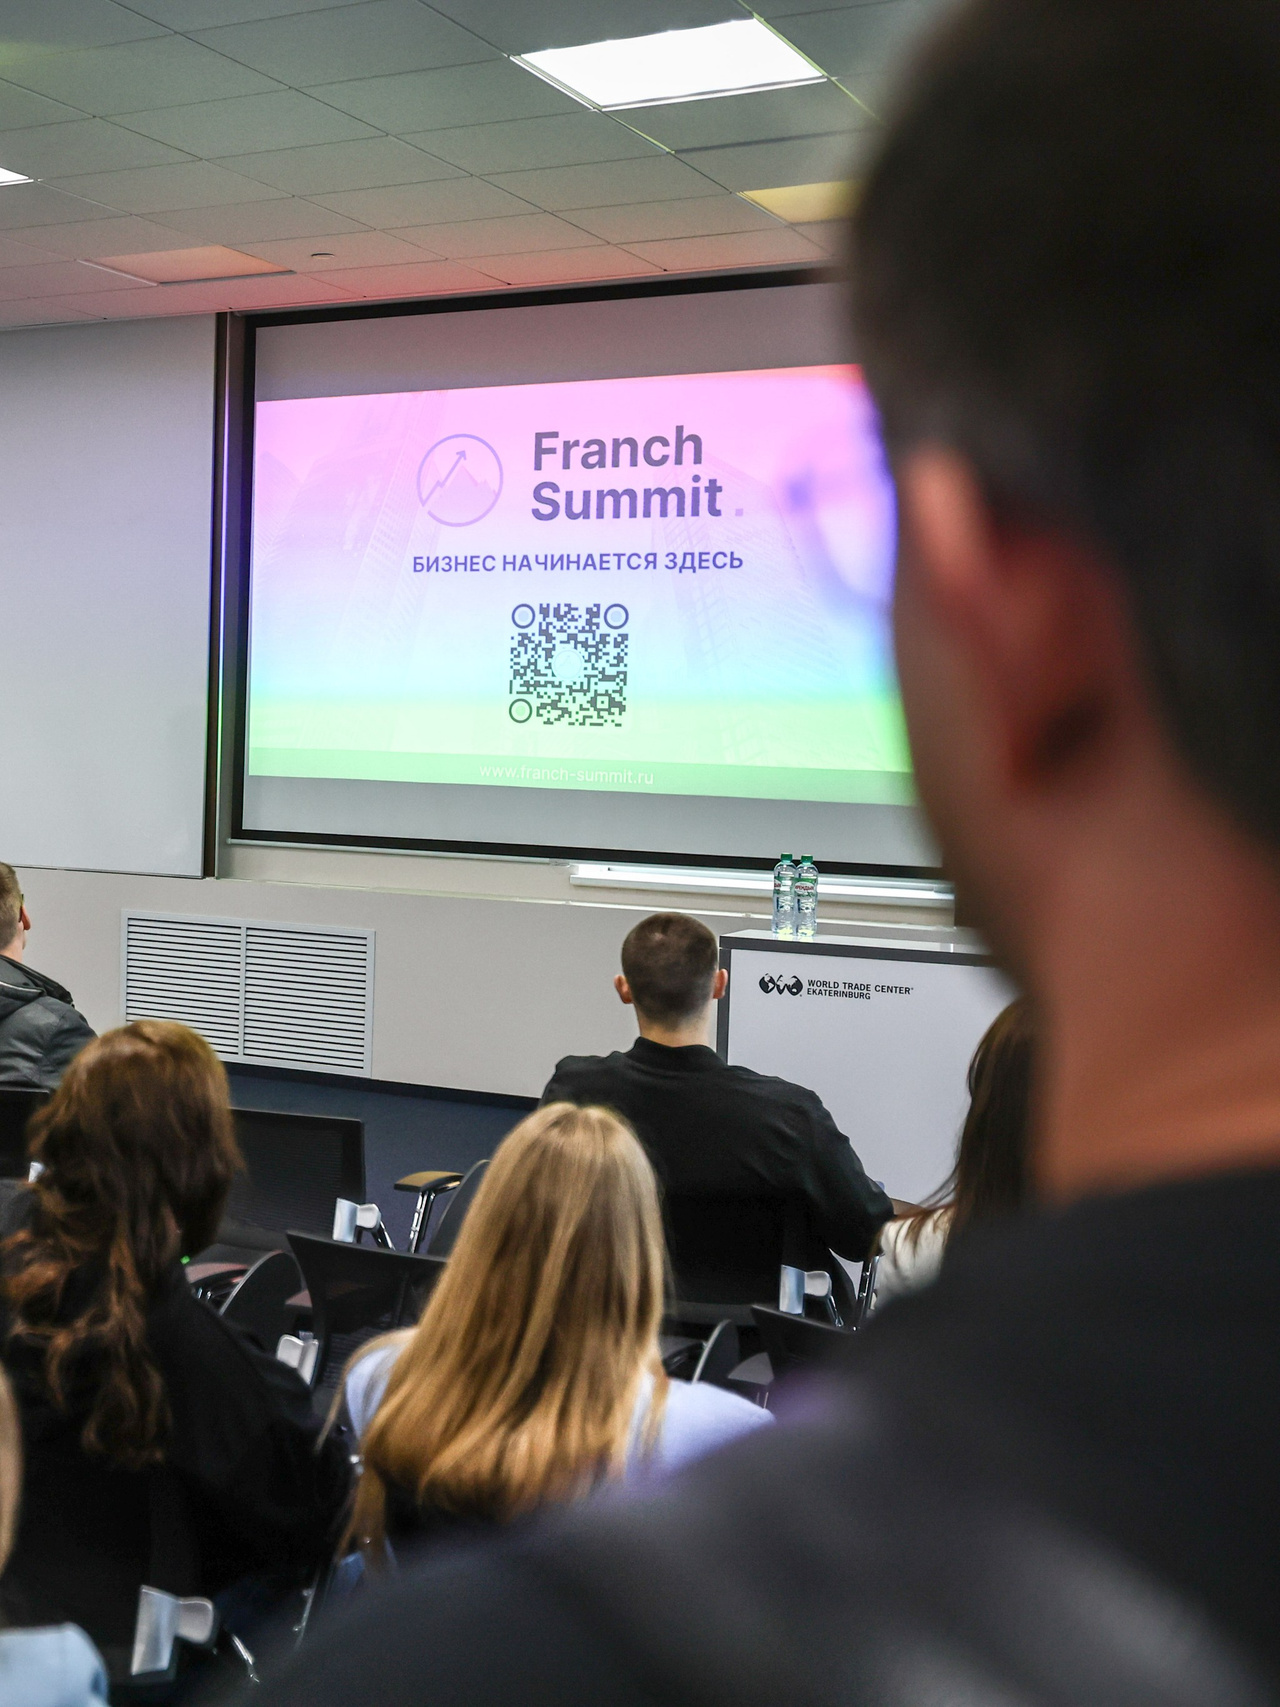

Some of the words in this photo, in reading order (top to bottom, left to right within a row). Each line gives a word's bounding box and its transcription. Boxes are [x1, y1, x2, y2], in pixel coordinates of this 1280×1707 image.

[534, 425, 703, 471] Franch
[412, 555, 496, 573] БИЗНЕС
[502, 552, 658, 572] НАЧИНАЕТСЯ
[664, 551, 744, 574] ЗДЕСЬ
[479, 764, 655, 785] www.franch-summit.ru
[807, 979, 840, 989] WORLD
[842, 982, 872, 992] TRADE
[807, 988, 871, 1000] EKATERINBURG
